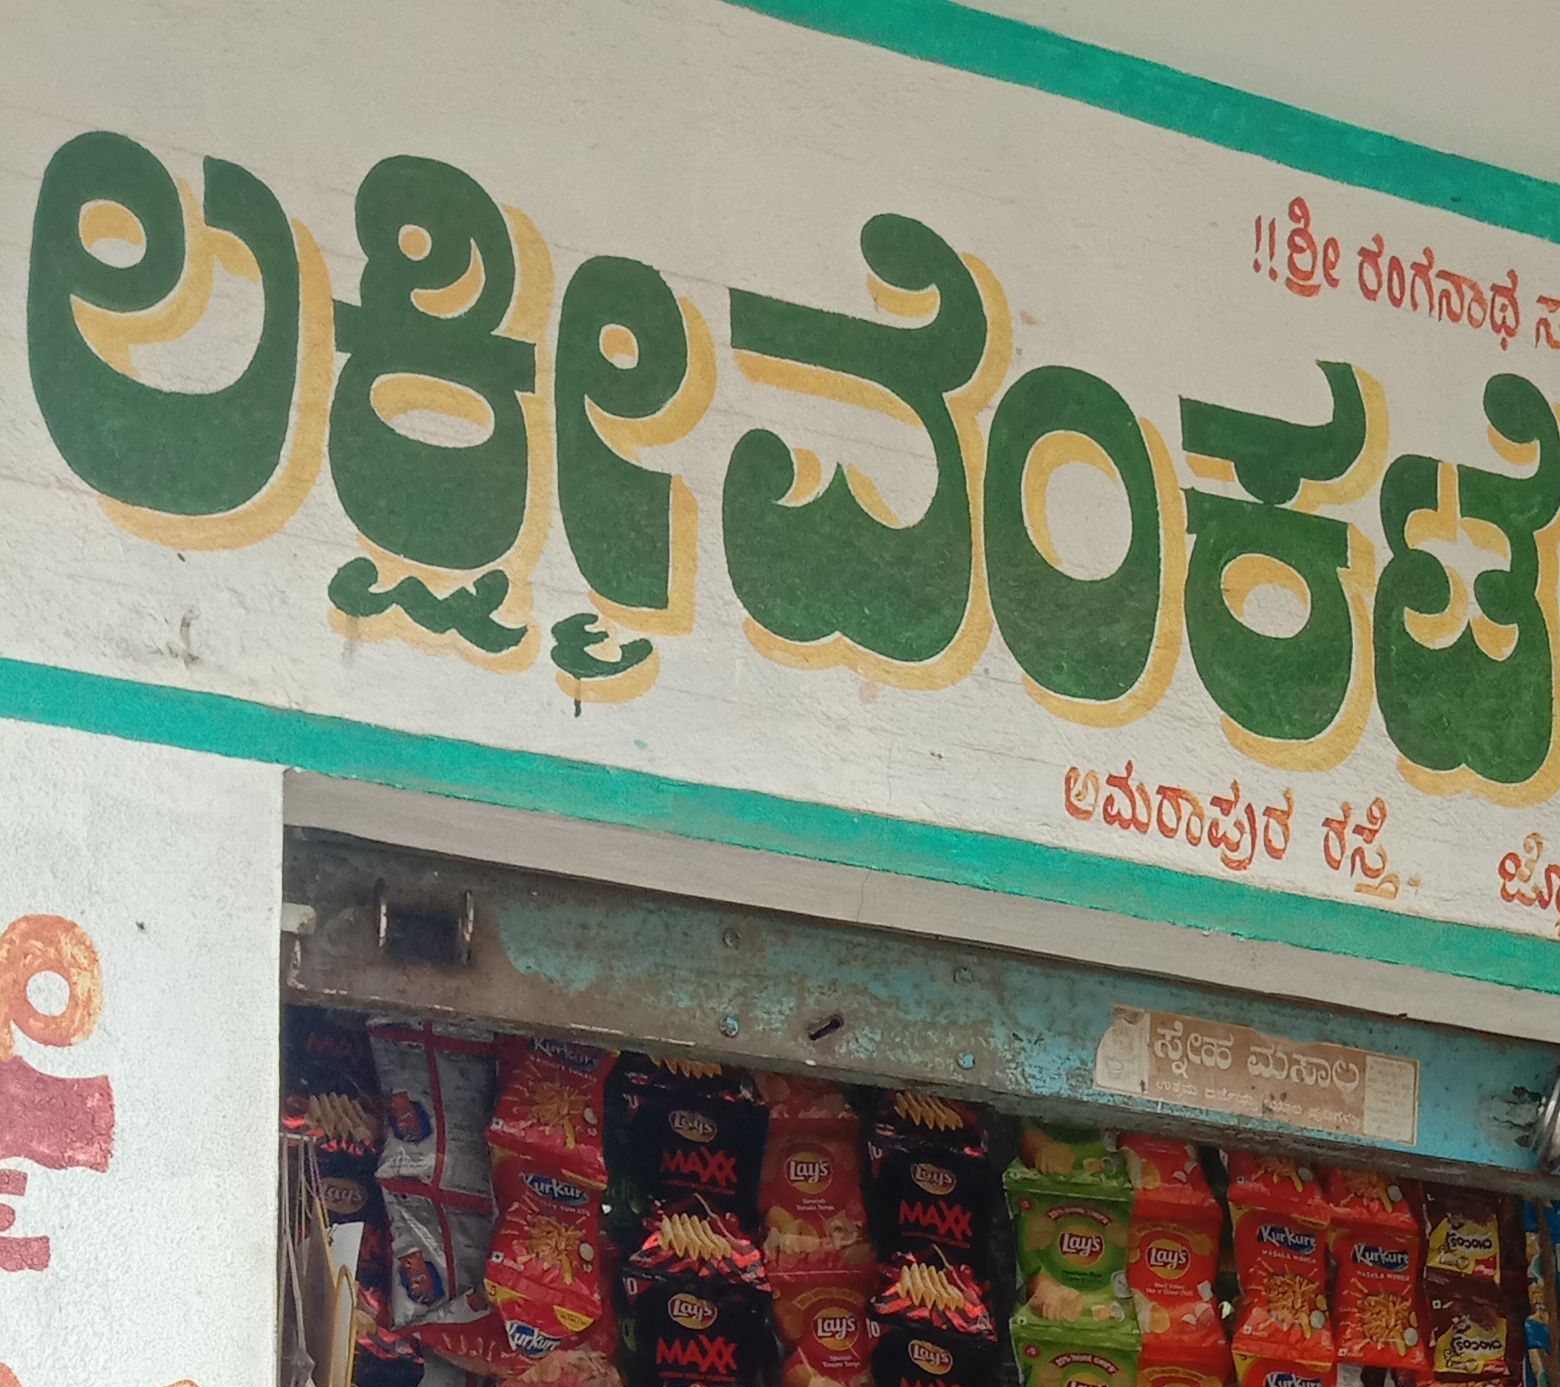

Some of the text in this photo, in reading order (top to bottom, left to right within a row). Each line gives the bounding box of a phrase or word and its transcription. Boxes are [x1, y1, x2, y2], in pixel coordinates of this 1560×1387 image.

[1357, 233, 1520, 350] ರಂಗನಾಥ
[661, 1147, 737, 1186] MAXX
[788, 1154, 830, 1184] Lay's
[900, 1201, 973, 1241] MAXX
[1062, 1230, 1102, 1256] Lay's
[1149, 1245, 1188, 1270] Lay's
[817, 1310, 856, 1342] Lay's
[656, 1335, 737, 1375] MAXX
